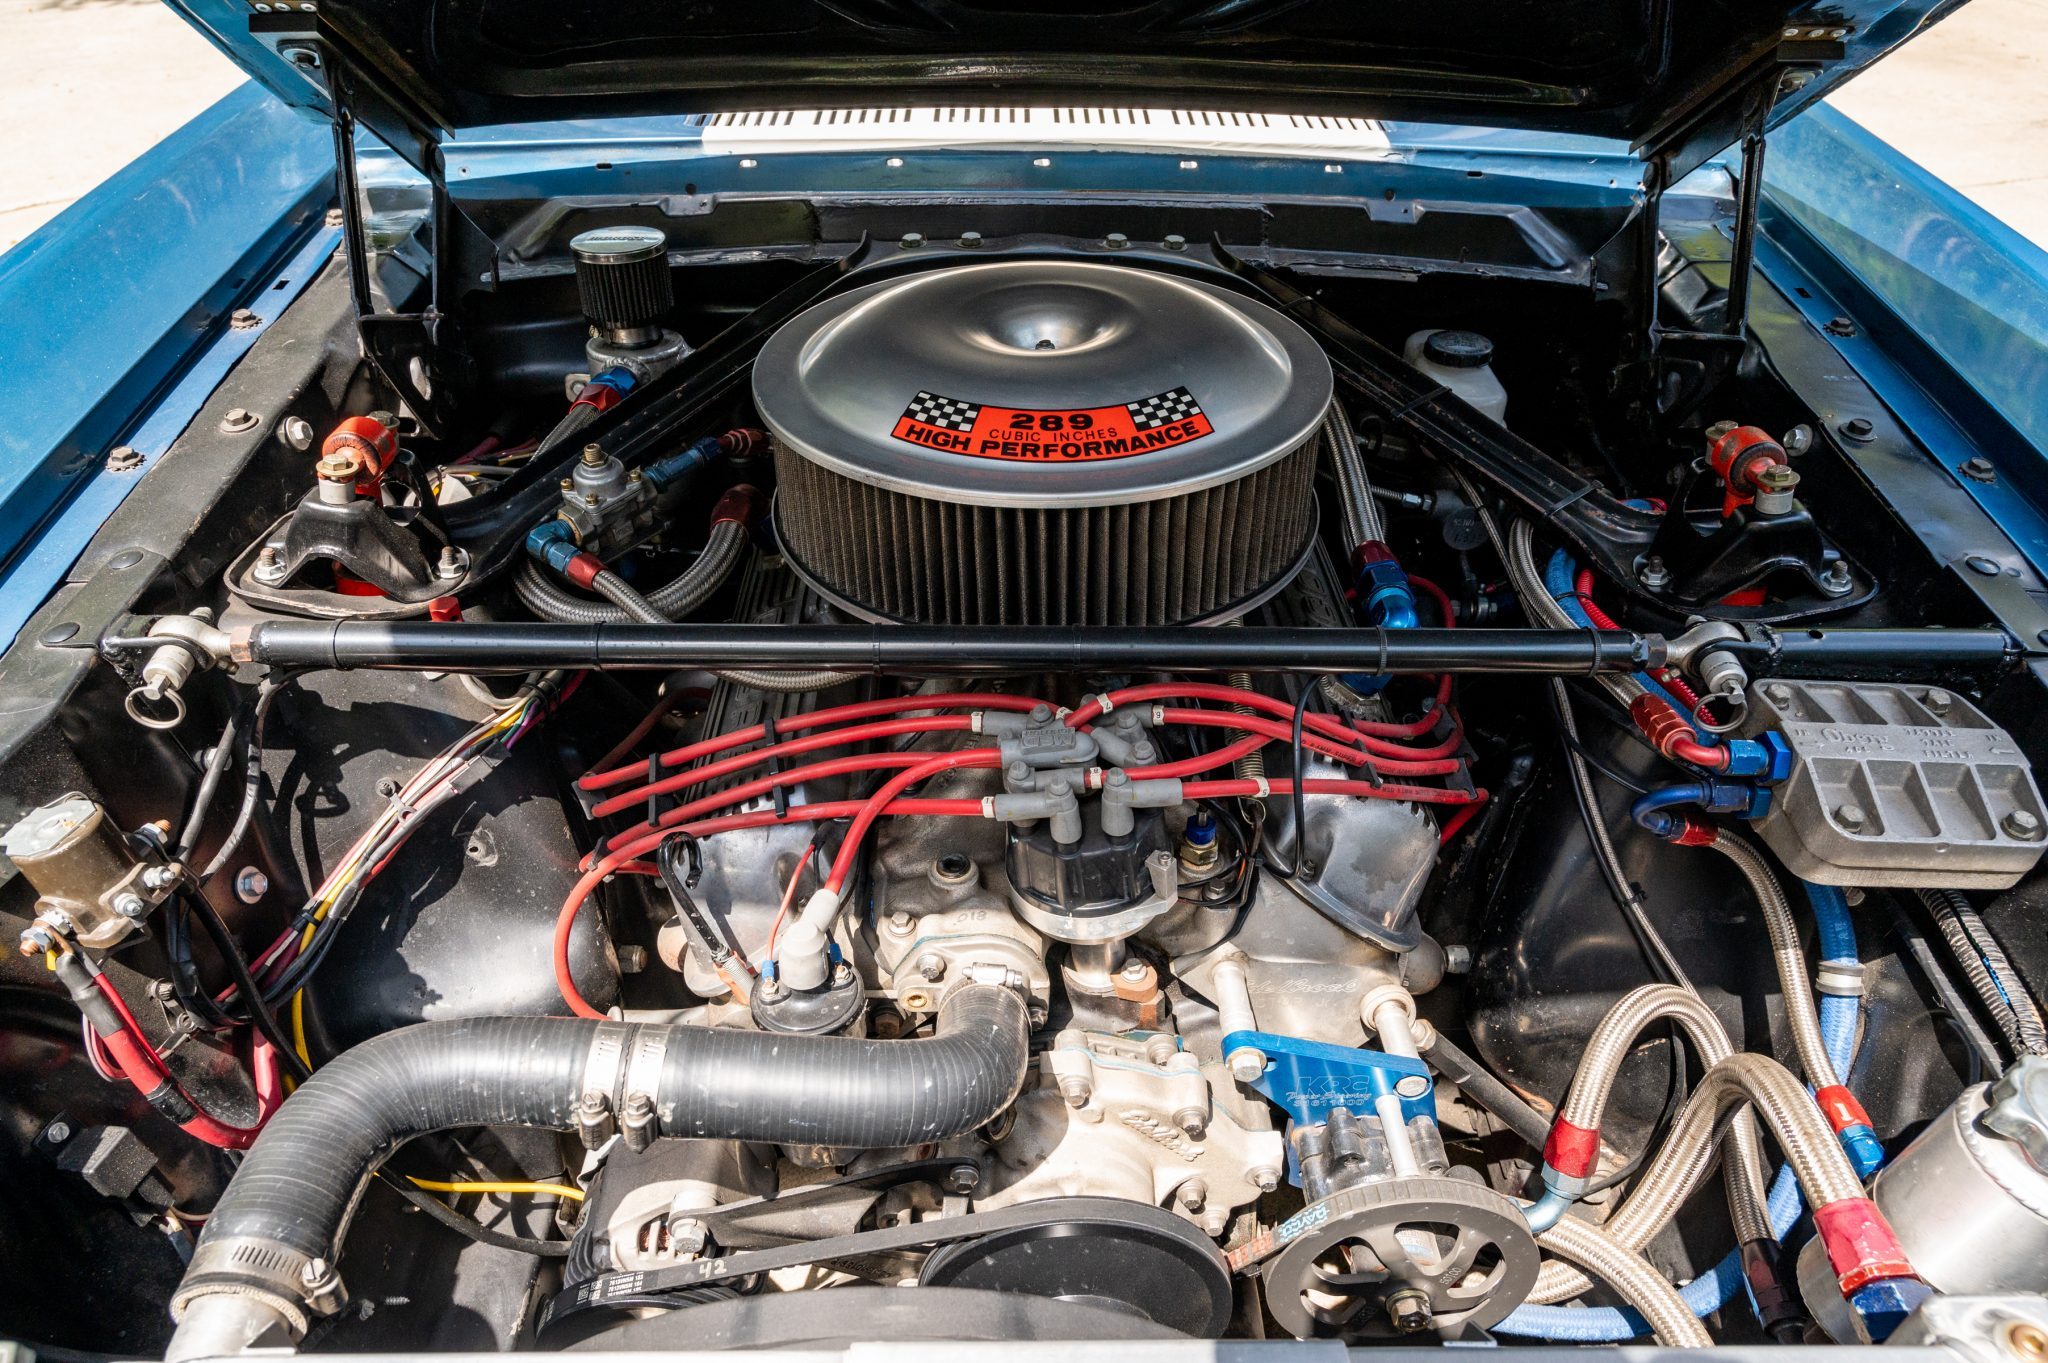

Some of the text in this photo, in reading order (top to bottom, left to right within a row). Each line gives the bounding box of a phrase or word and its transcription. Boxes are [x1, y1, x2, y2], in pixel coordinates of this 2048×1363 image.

[1010, 413, 1093, 431] 289
[904, 421, 1200, 458] HIGH PERFORMANCE
[989, 427, 1118, 443] CUBIC INCHES
[1296, 1075, 1370, 1096] KRC
[1834, 1102, 1855, 1121] 1
[699, 1259, 727, 1280] 42
